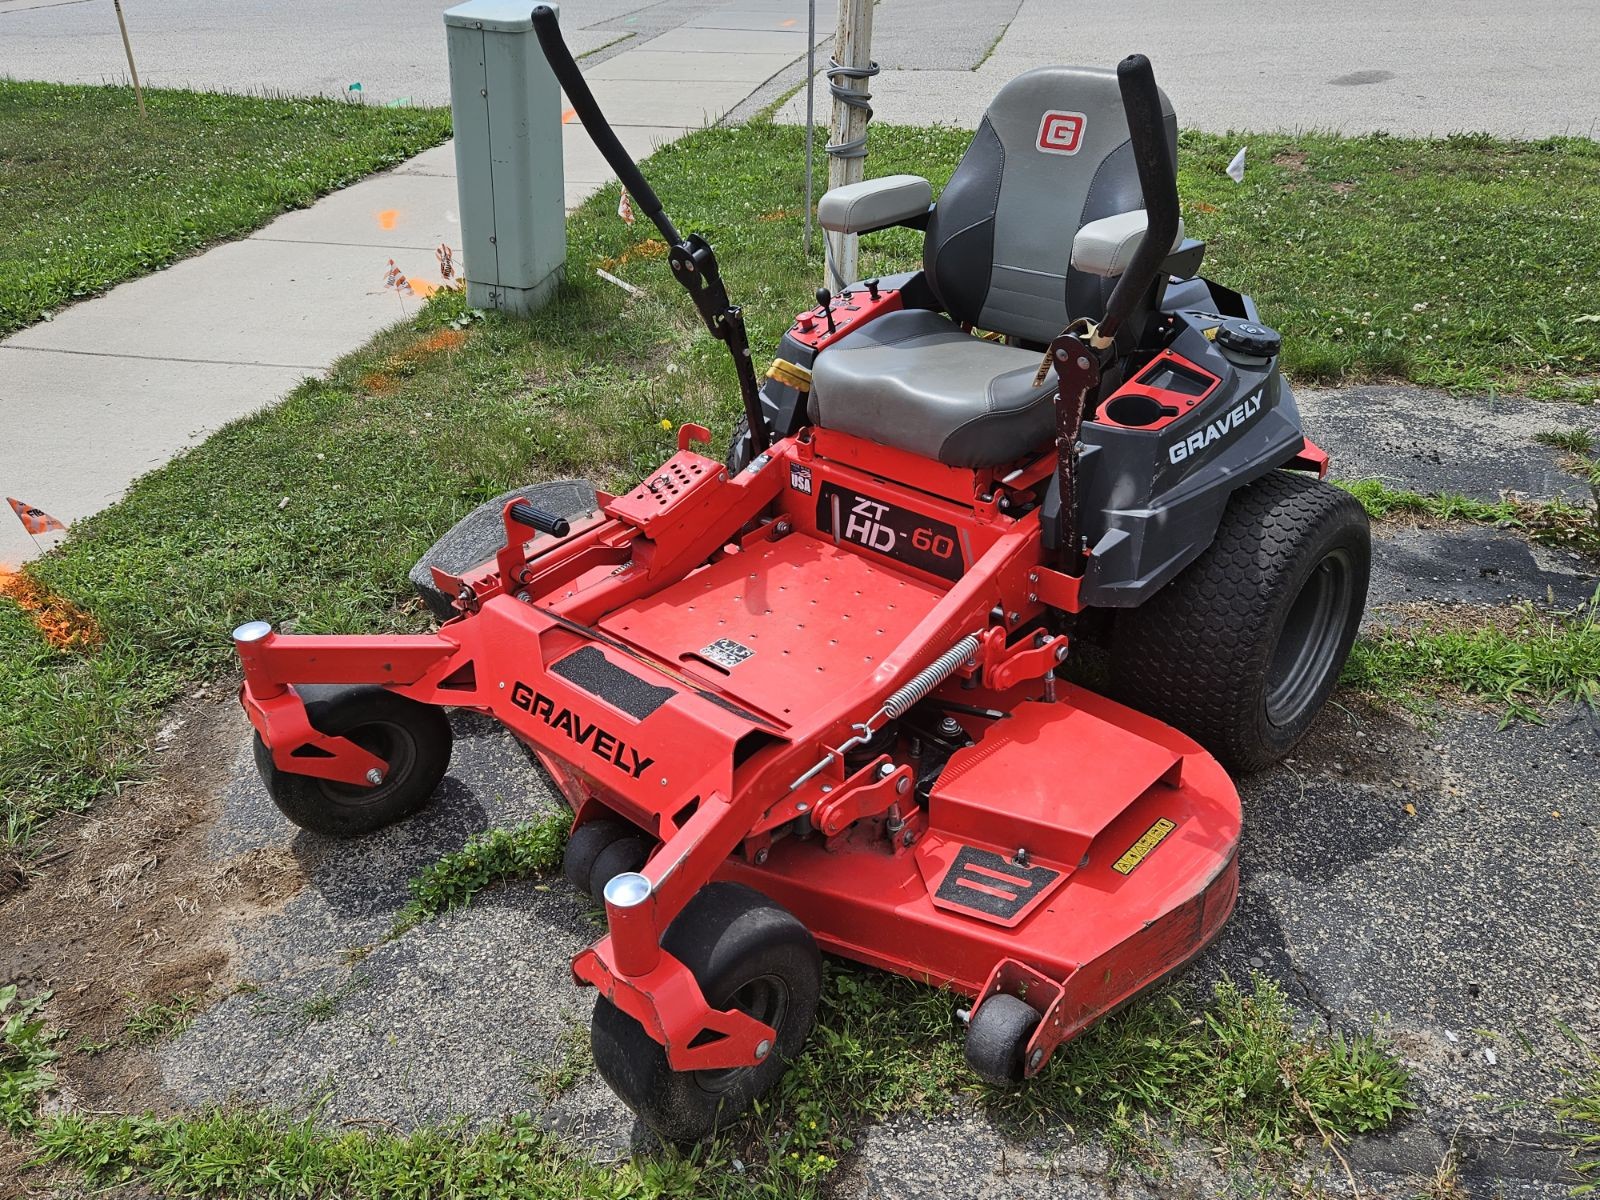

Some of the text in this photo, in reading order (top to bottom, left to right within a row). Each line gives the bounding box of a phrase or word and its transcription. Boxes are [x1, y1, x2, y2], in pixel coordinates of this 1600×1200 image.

[1168, 388, 1263, 465] GRAVELY
[791, 473, 811, 493] USA
[851, 496, 890, 521] ZT
[510, 680, 655, 779] GRAVELY
